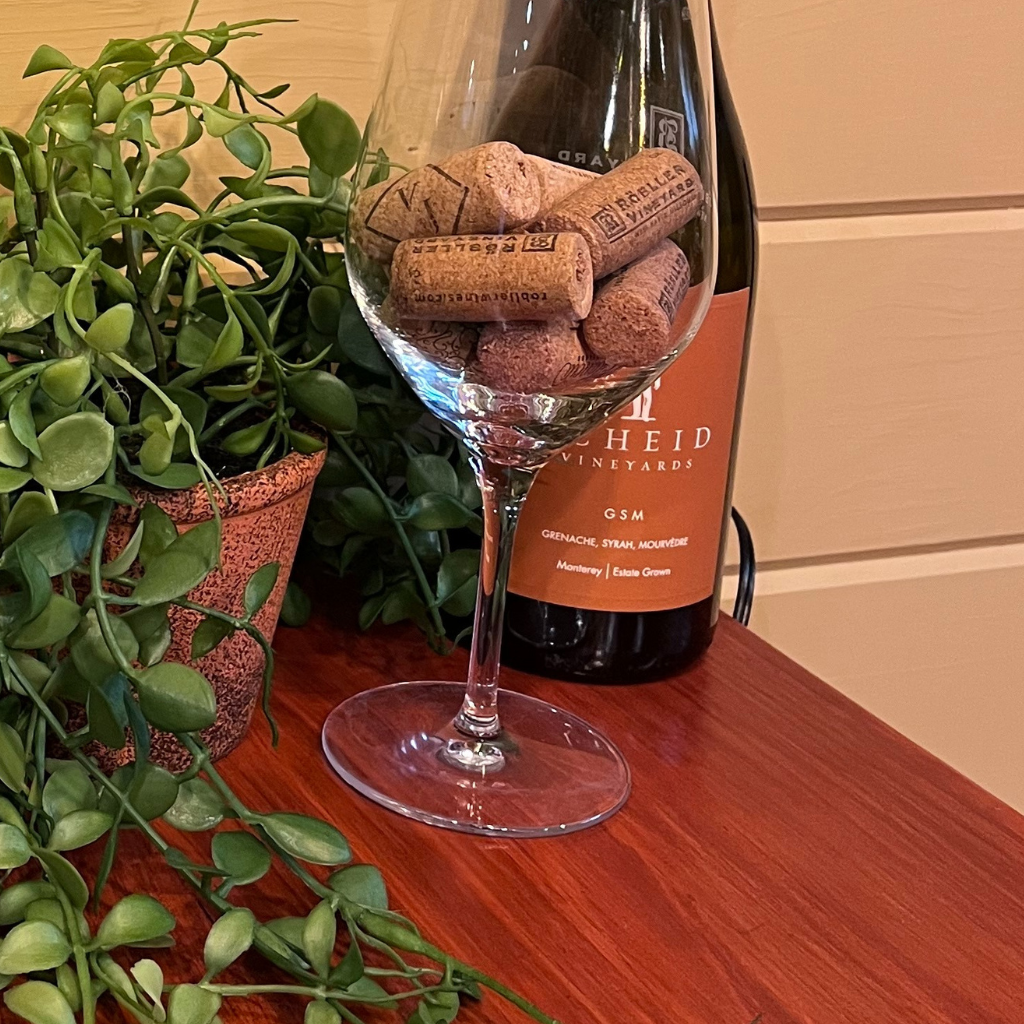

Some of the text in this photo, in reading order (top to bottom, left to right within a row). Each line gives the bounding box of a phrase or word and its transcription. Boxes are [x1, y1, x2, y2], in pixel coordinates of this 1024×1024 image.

[615, 164, 686, 211] RÖBLLER
[625, 177, 695, 223] VINEYARD
[412, 243, 515, 255] RÖBLLER
[576, 426, 711, 452] HEID
[561, 452, 693, 471] VINEYARDS
[604, 508, 644, 521] GSM
[541, 529, 599, 548] GRENACHE,
[601, 538, 636, 550] SYRAH,
[556, 559, 671, 578] Monterey Estate Grown
